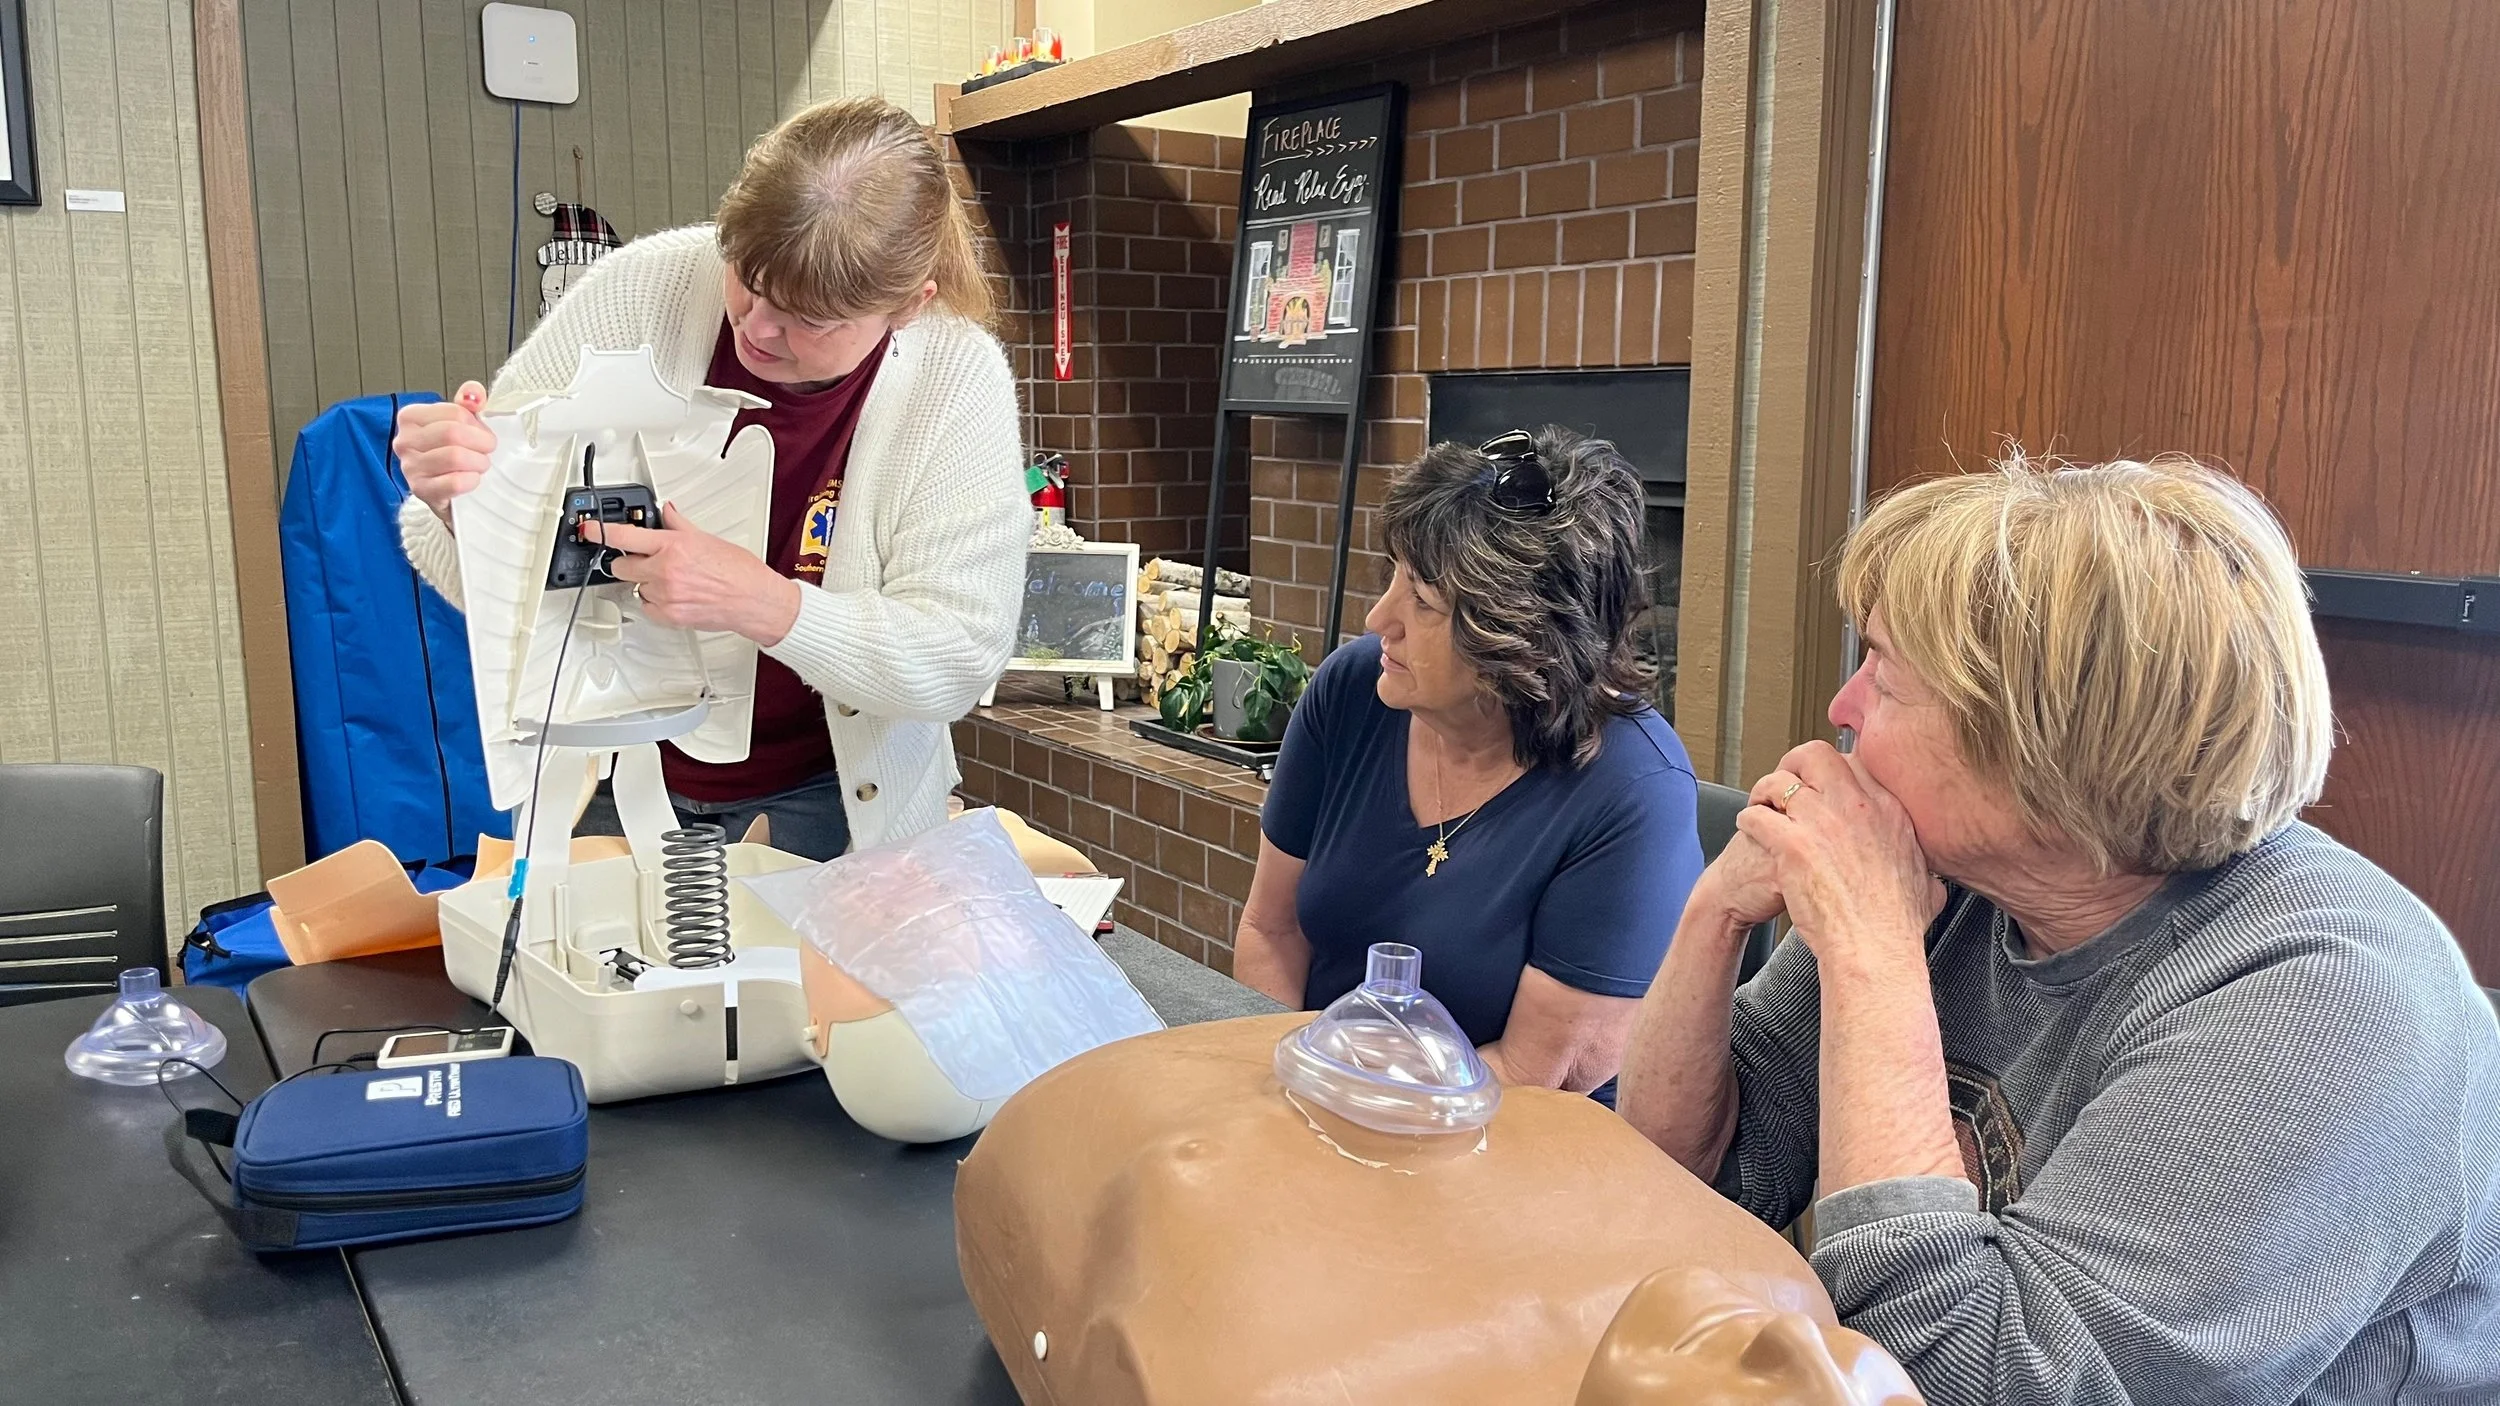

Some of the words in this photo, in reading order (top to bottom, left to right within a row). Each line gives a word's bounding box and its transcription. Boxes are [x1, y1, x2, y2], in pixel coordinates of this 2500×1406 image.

[1261, 117, 1342, 159] FIREPLACE
[1253, 173, 1287, 211] Read
[1294, 169, 1328, 205] Relax
